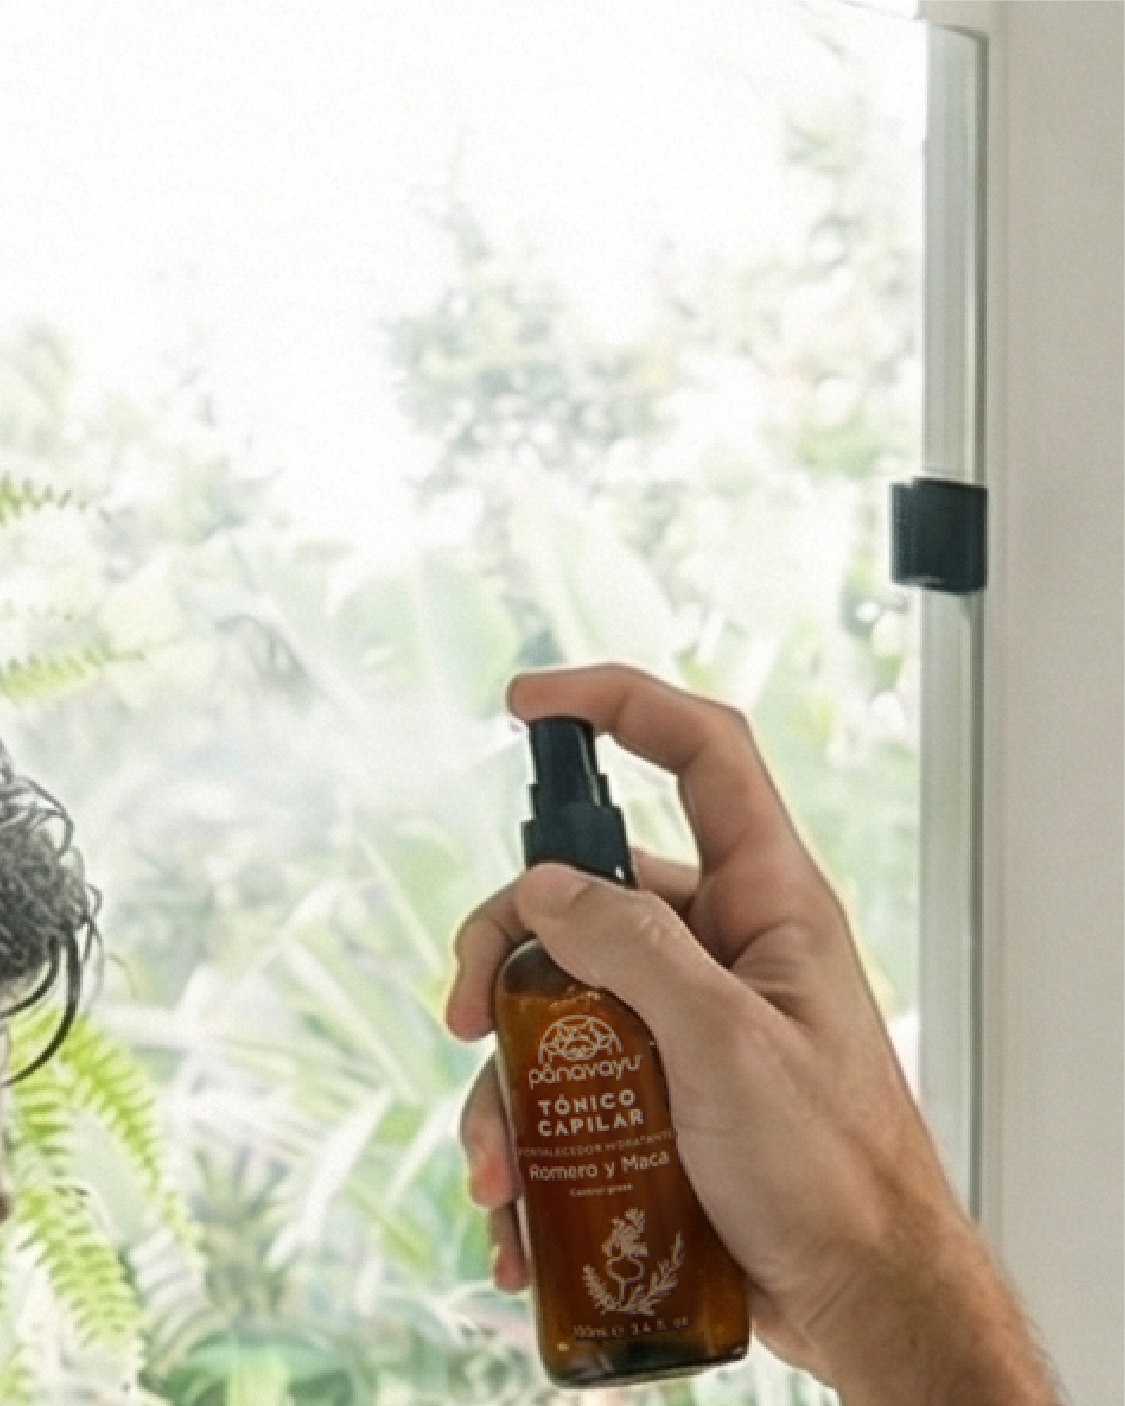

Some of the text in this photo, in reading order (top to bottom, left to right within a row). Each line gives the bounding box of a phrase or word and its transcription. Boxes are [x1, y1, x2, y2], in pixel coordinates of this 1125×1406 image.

[537, 1088, 636, 1117] TÓNICO
[537, 1108, 644, 1137] CAPILAR
[529, 1150, 670, 1181] Romero y Maca
